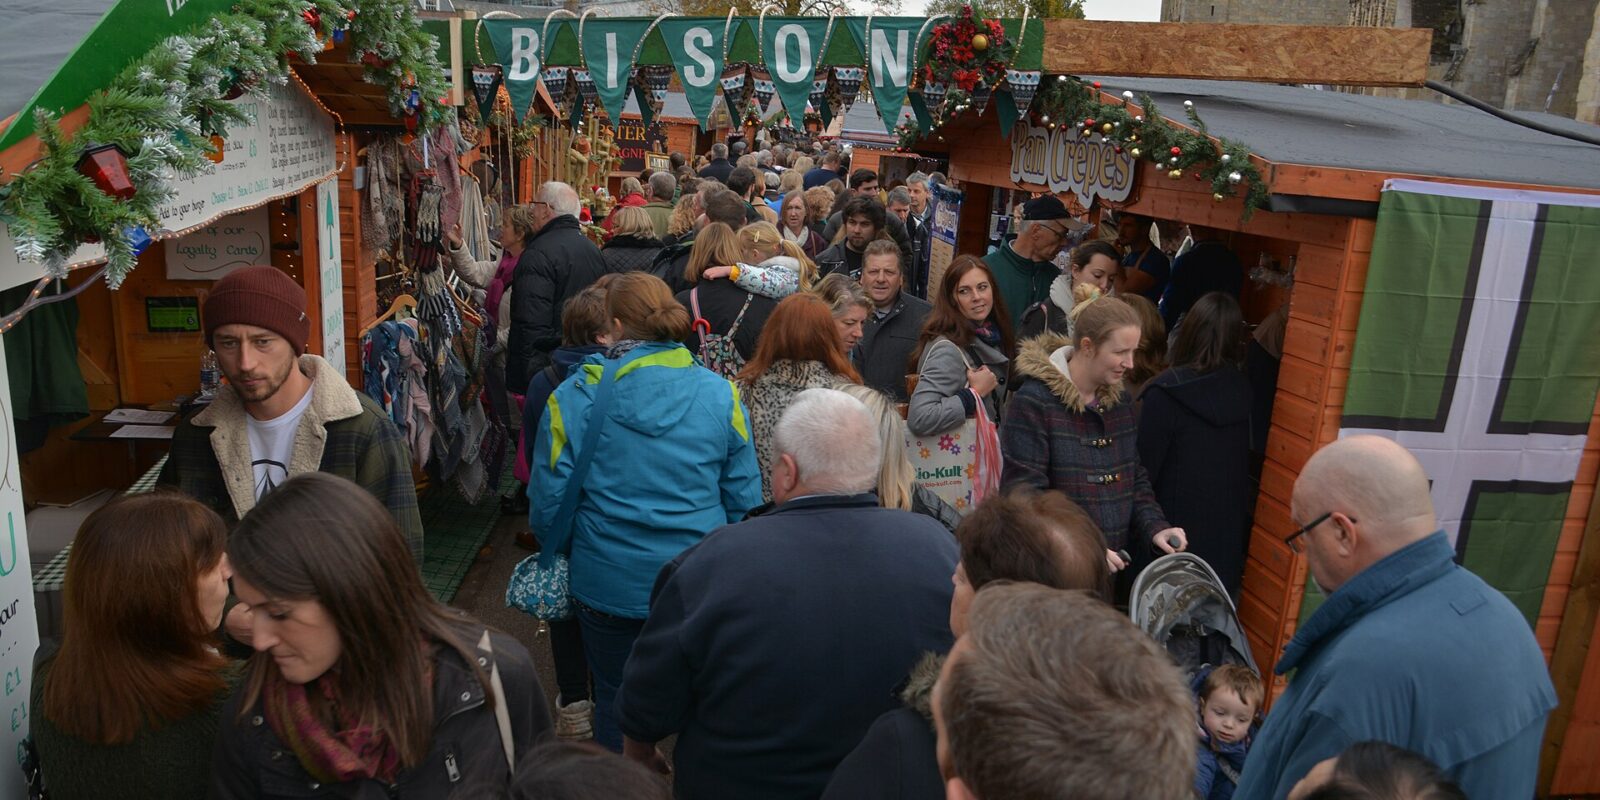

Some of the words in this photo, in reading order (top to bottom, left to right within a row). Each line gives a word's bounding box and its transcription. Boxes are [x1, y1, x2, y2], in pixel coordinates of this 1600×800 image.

[510, 24, 910, 89] BISON
[1012, 120, 1048, 176] Pan
[159, 206, 170, 220] Add
[172, 203, 178, 216] to
[179, 203, 191, 220] your
[223, 226, 246, 235] our
[176, 243, 217, 260] Loyalty
[226, 244, 258, 256] Cards
[915, 465, 962, 480] io-Kult
[5, 665, 22, 697] £1
[11, 701, 28, 733] £1
